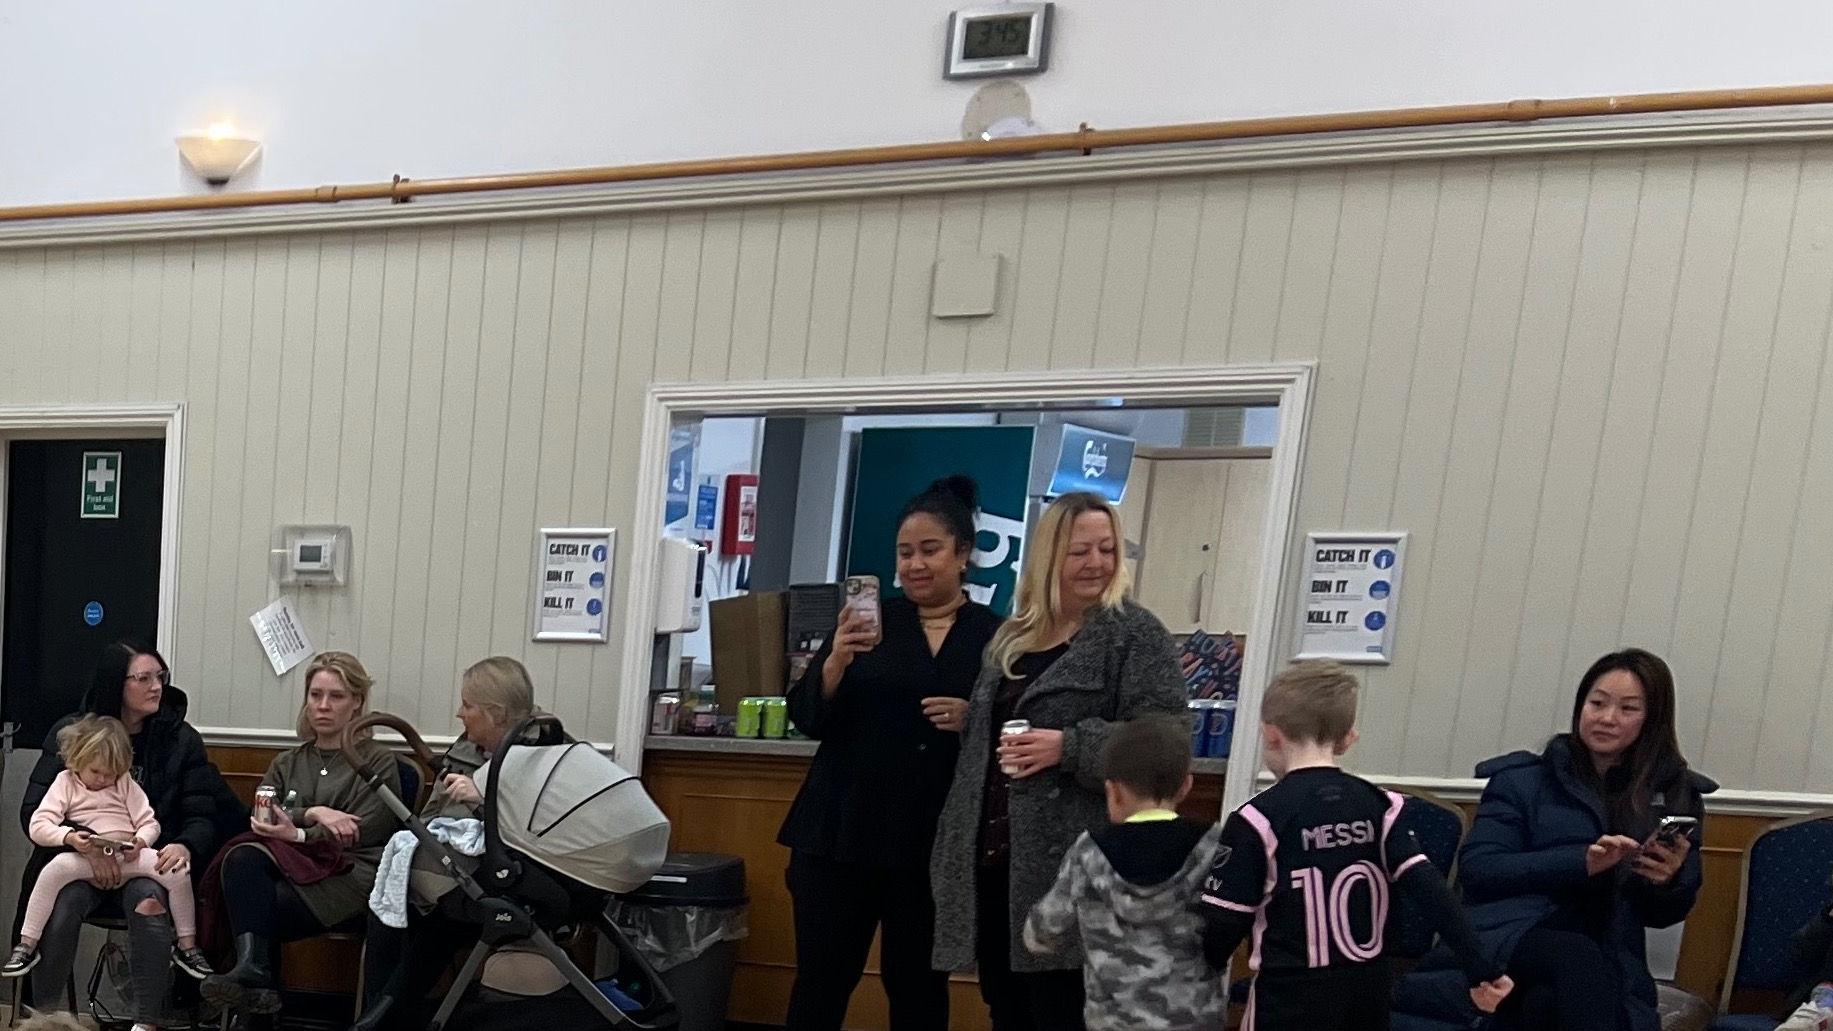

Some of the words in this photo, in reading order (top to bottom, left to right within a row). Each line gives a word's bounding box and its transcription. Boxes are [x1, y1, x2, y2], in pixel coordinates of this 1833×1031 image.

[549, 543, 579, 556] CATCH
[581, 543, 591, 556] IT
[1315, 549, 1355, 563] CATCH
[1358, 549, 1372, 563] IT
[546, 570, 563, 582] BIN
[564, 570, 574, 582] IT
[1311, 580, 1332, 593] BIN
[1335, 580, 1349, 593] IT
[543, 596, 563, 609] KILL
[564, 597, 575, 609] IT
[1307, 610, 1332, 624] KILL
[1335, 610, 1349, 624] IT
[1301, 819, 1375, 851] MESSI
[1290, 860, 1390, 969] 10
